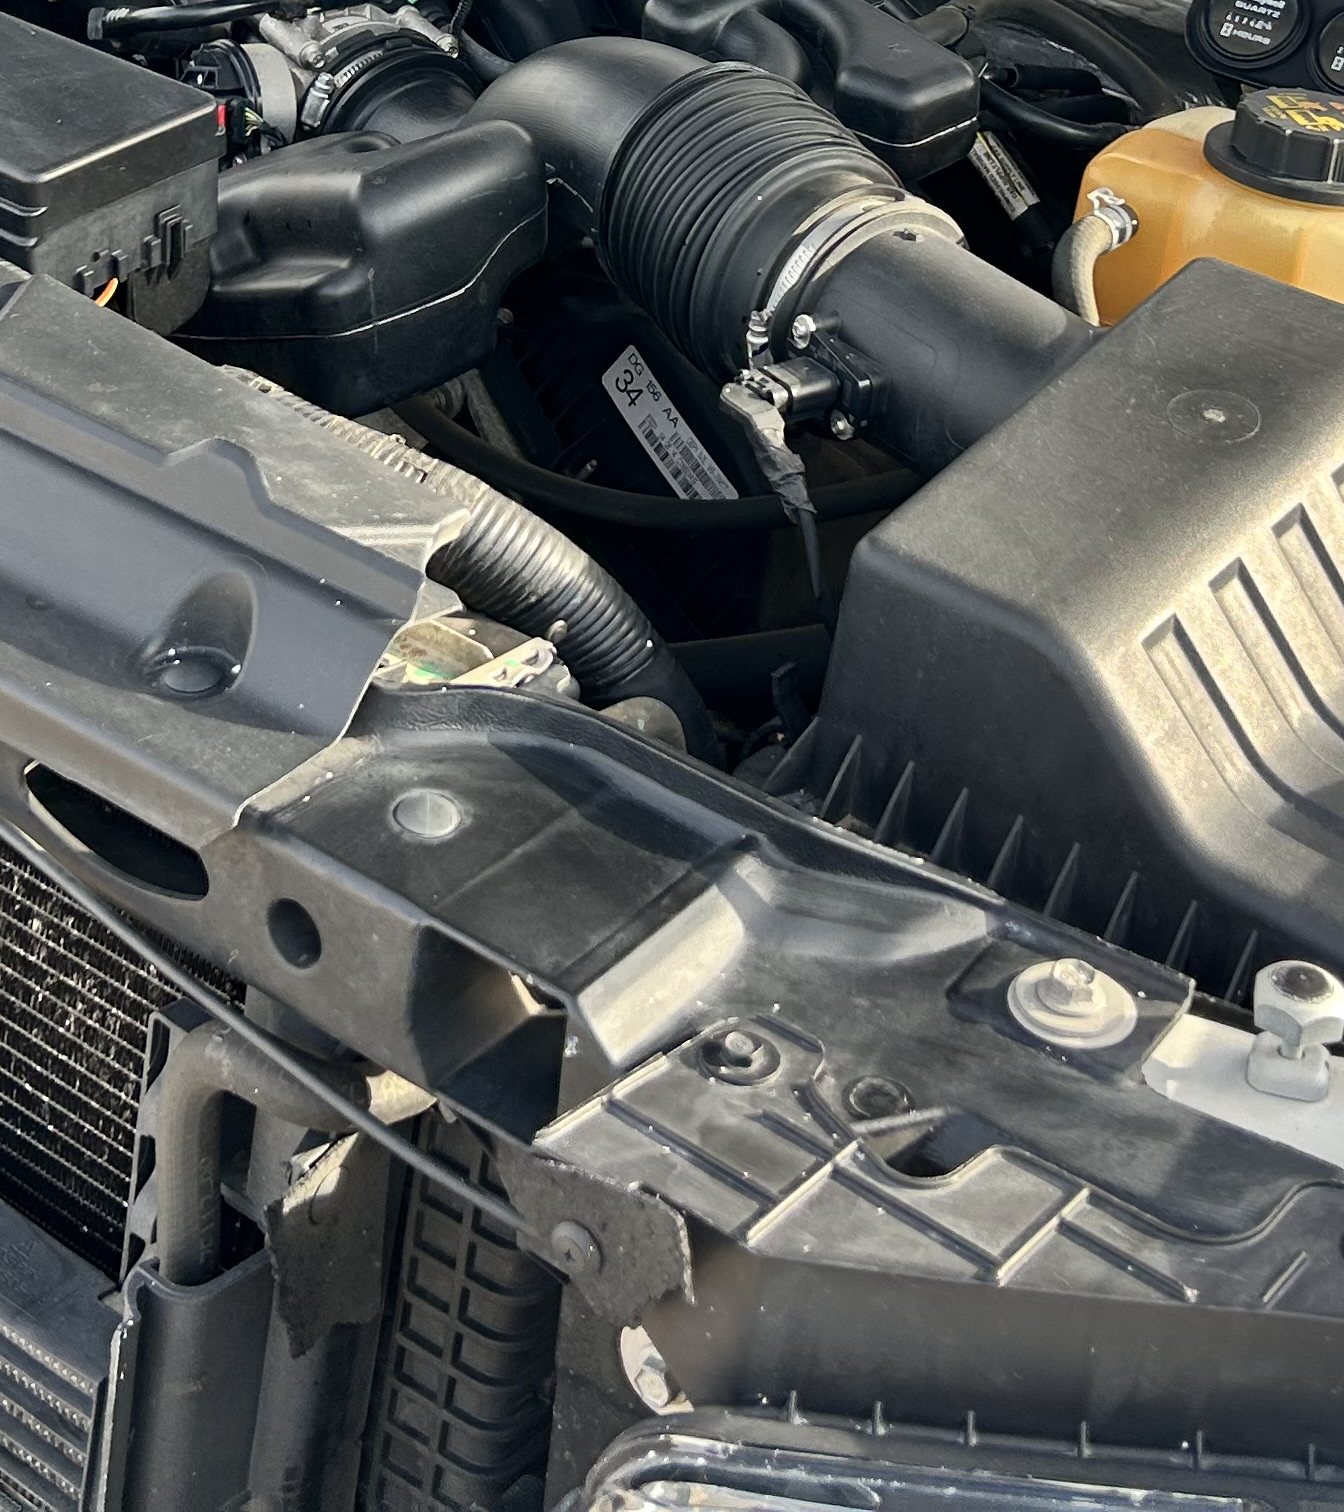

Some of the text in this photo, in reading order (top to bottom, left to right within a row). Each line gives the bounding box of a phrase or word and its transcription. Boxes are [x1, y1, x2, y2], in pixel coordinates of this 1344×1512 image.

[1235, 0, 1281, 18] QUARTZ
[615, 368, 644, 407] 34
[628, 352, 680, 429] DG 156 AA
